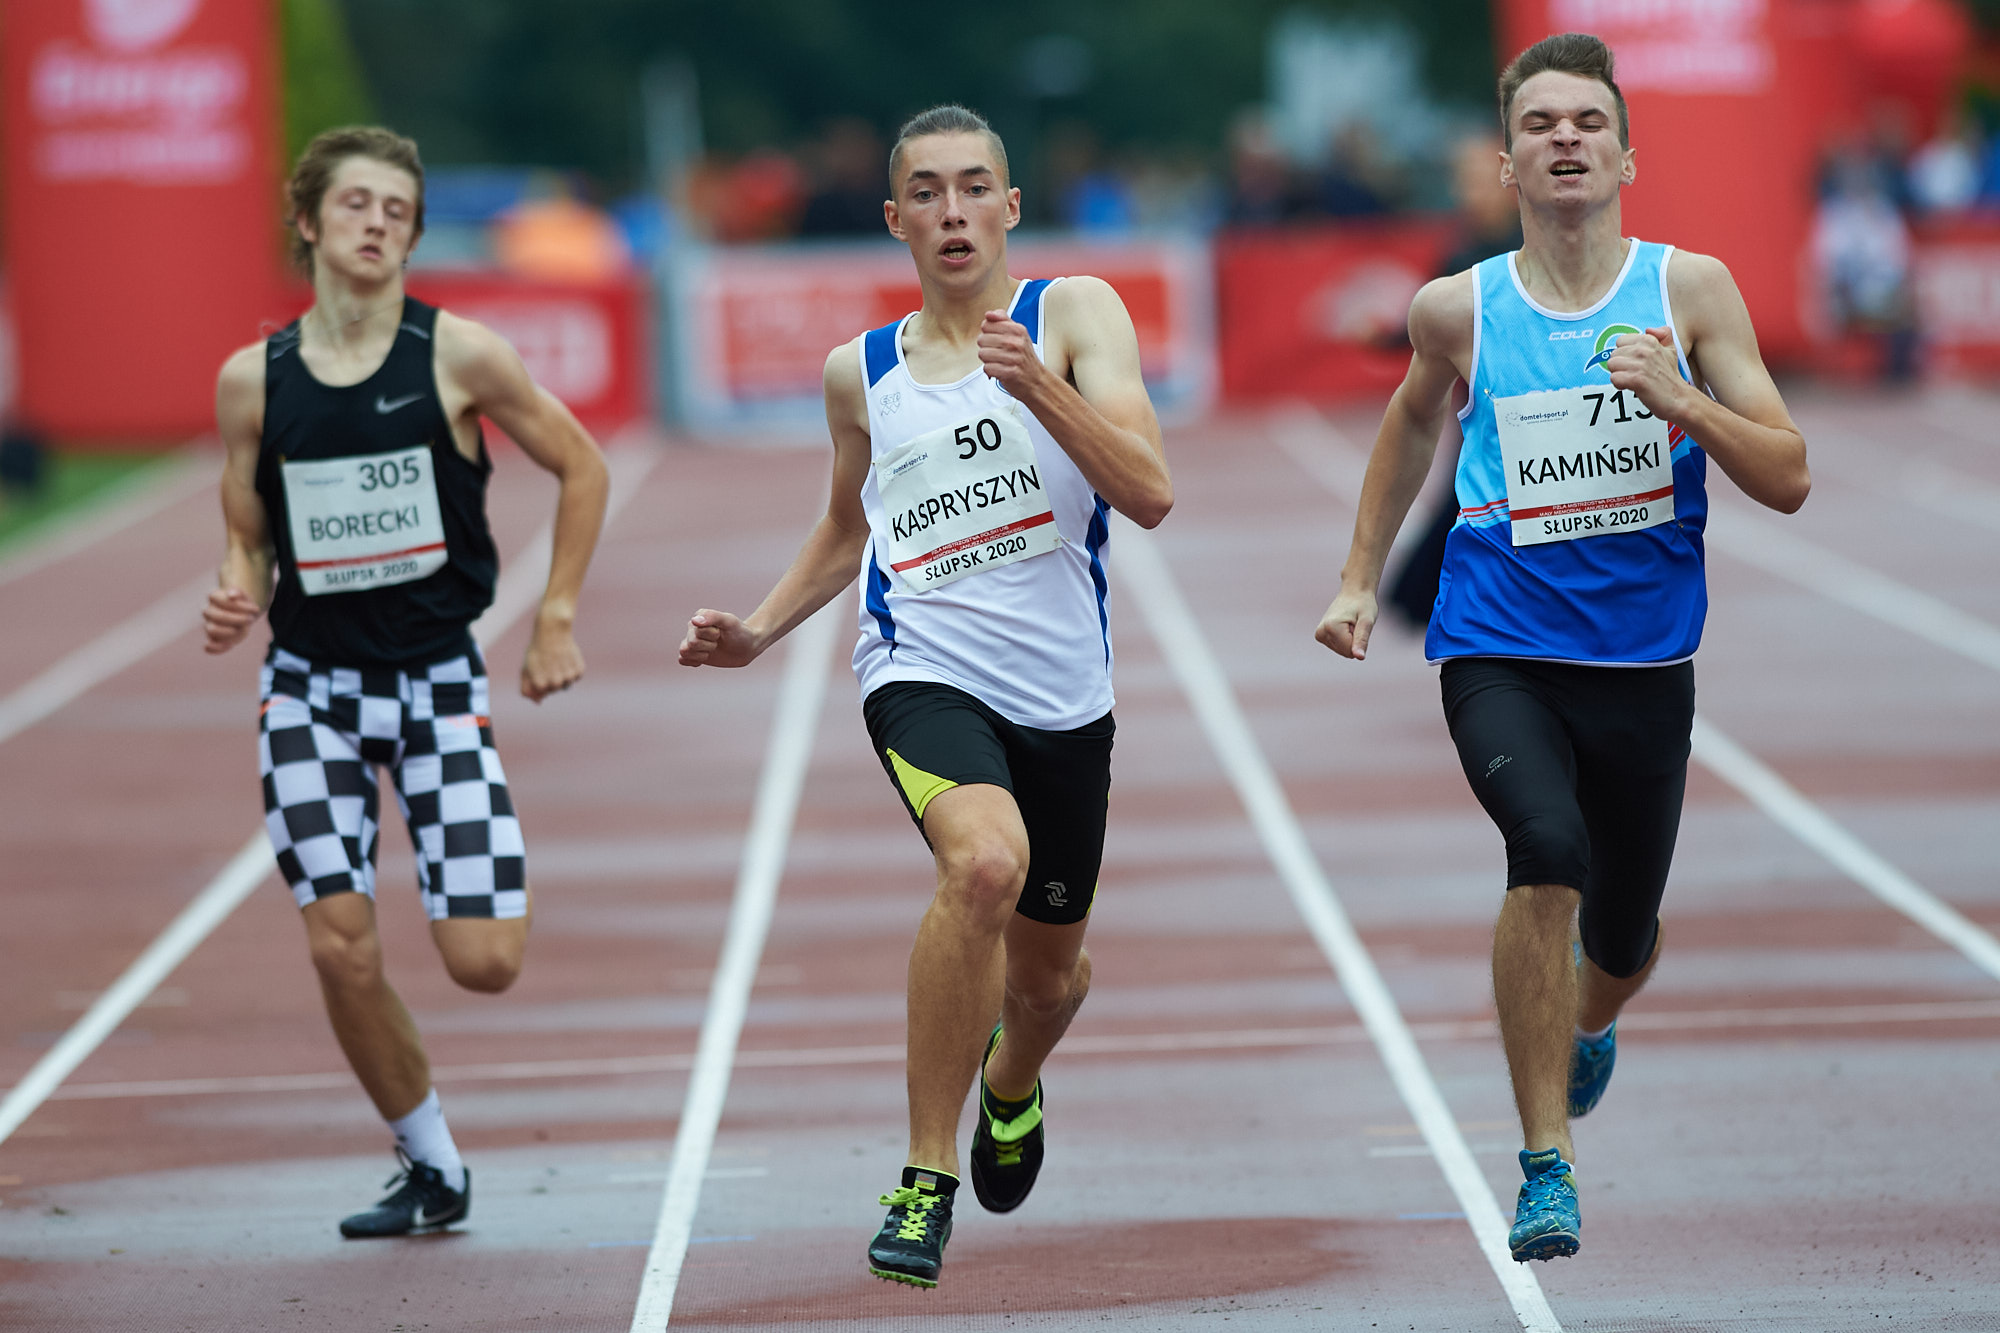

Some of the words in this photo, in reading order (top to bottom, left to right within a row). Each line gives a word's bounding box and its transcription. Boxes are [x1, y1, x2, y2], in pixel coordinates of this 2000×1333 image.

[1548, 329, 1594, 341] COLO
[1519, 410, 1569, 422] domtel-sport.pl
[954, 418, 1002, 460] 50
[359, 455, 420, 492] 305
[1518, 441, 1660, 487] KAMIŃSKI
[892, 464, 1041, 543] KASPRYSZYN
[1544, 513, 1605, 535] SŁUPSK
[1609, 507, 1649, 527] 2020
[309, 504, 420, 542] BORECKI
[325, 567, 377, 585] SŁUPSK
[383, 560, 419, 578] 2020
[925, 550, 983, 581] SŁUPSK
[986, 536, 1027, 561] 2020
